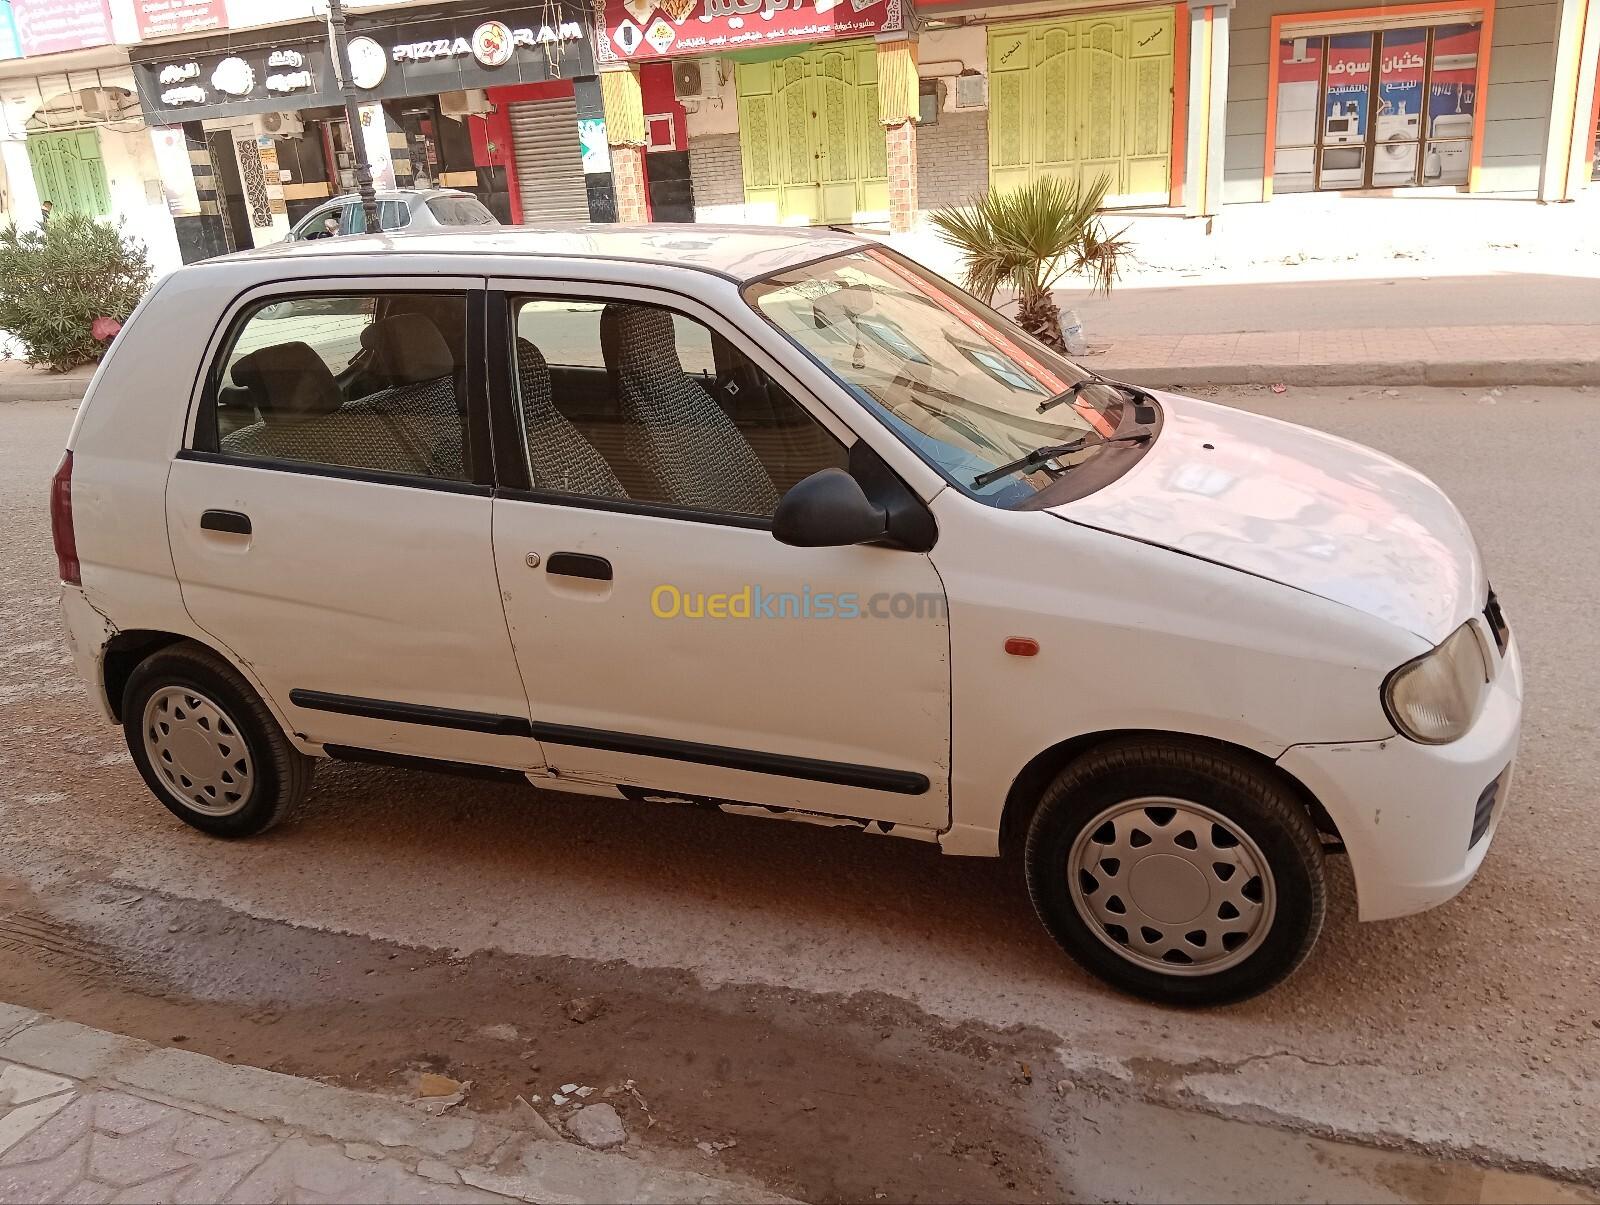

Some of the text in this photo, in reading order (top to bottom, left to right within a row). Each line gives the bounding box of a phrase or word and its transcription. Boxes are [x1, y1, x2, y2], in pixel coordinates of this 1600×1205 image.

[852, 18, 875, 31] مشروب
[393, 22, 584, 62] PIZZA RAM
[1137, 28, 1162, 47] مدرسة
[1000, 40, 1022, 64] النجاح
[1328, 52, 1424, 76] كثبان سوف
[1327, 84, 1369, 96] بالتقسيط
